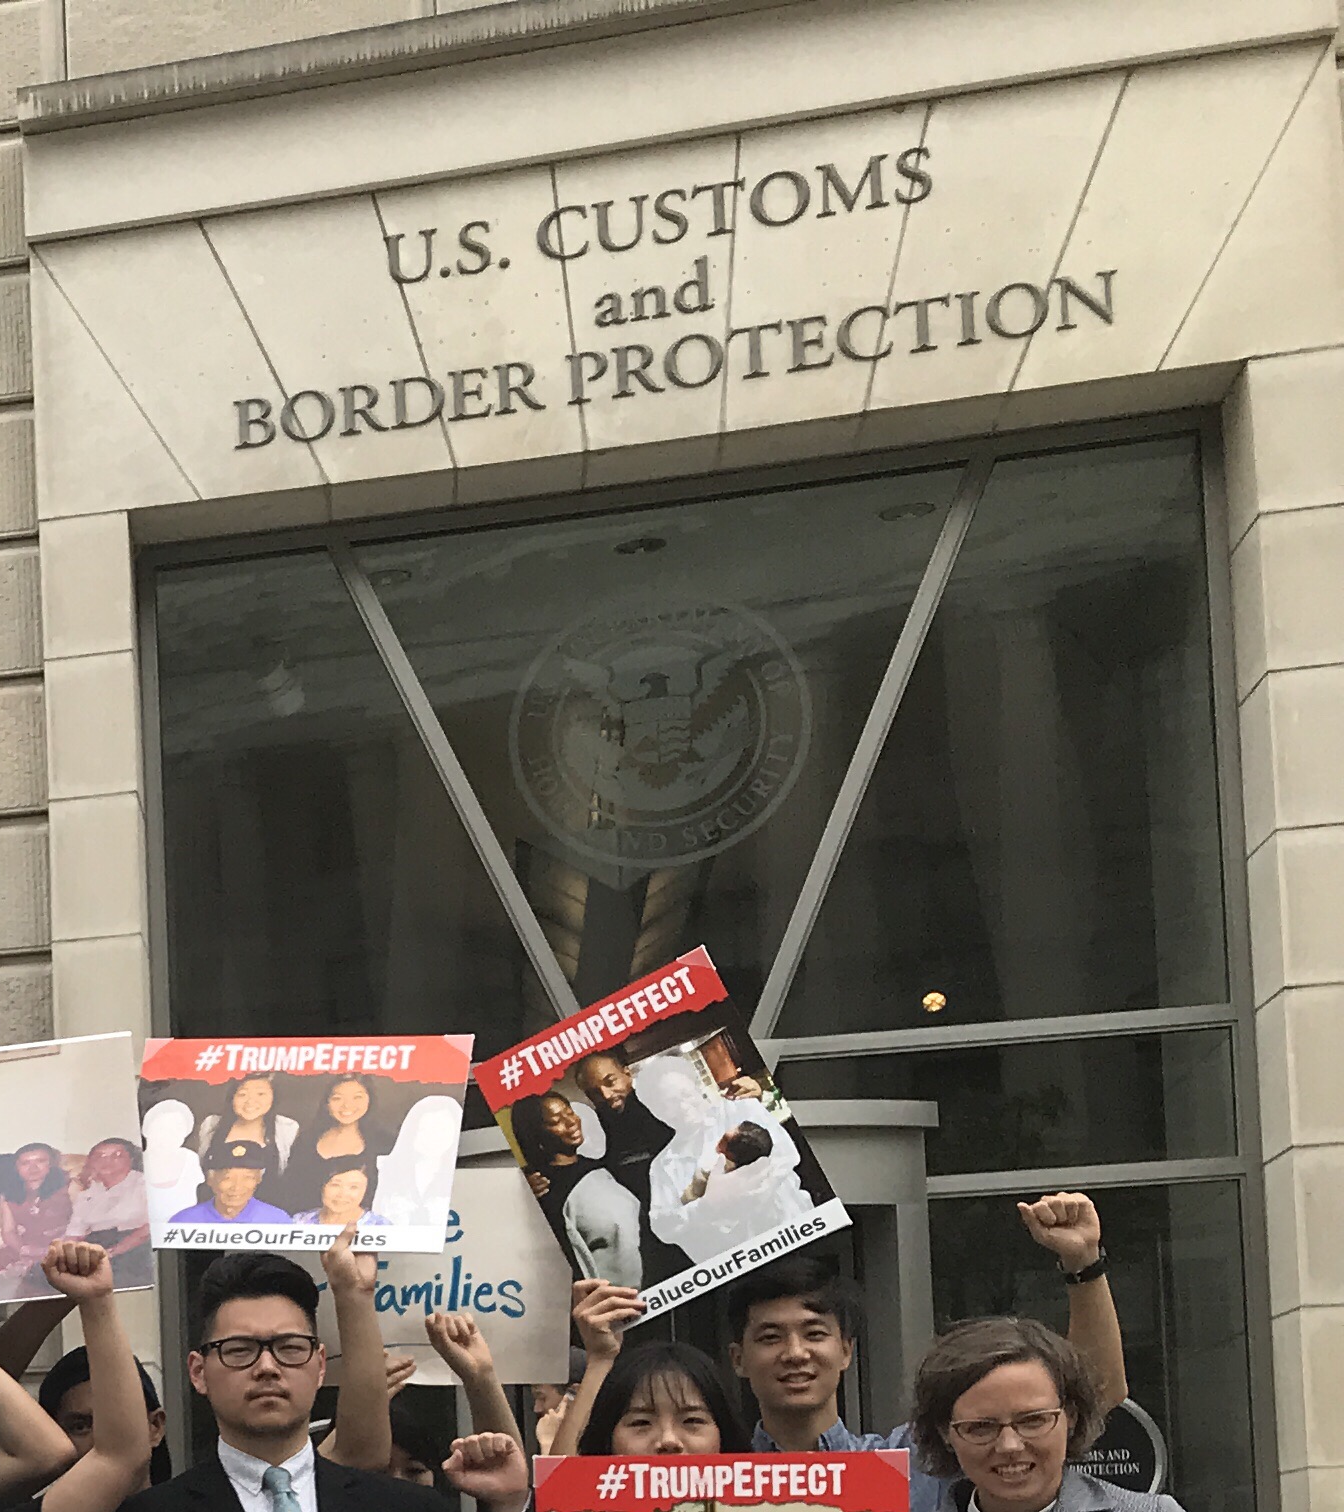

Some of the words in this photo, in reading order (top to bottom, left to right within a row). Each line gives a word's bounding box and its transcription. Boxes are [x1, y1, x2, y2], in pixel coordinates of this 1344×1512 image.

[385, 220, 511, 285] U.S.
[535, 147, 934, 262] CUSTOMS
[593, 255, 716, 328] and
[234, 360, 547, 452] BORDER
[565, 270, 1120, 406] PROTECTION
[163, 1228, 387, 1247] #ValueOurFamies
[1107, 1448, 1131, 1461] AND
